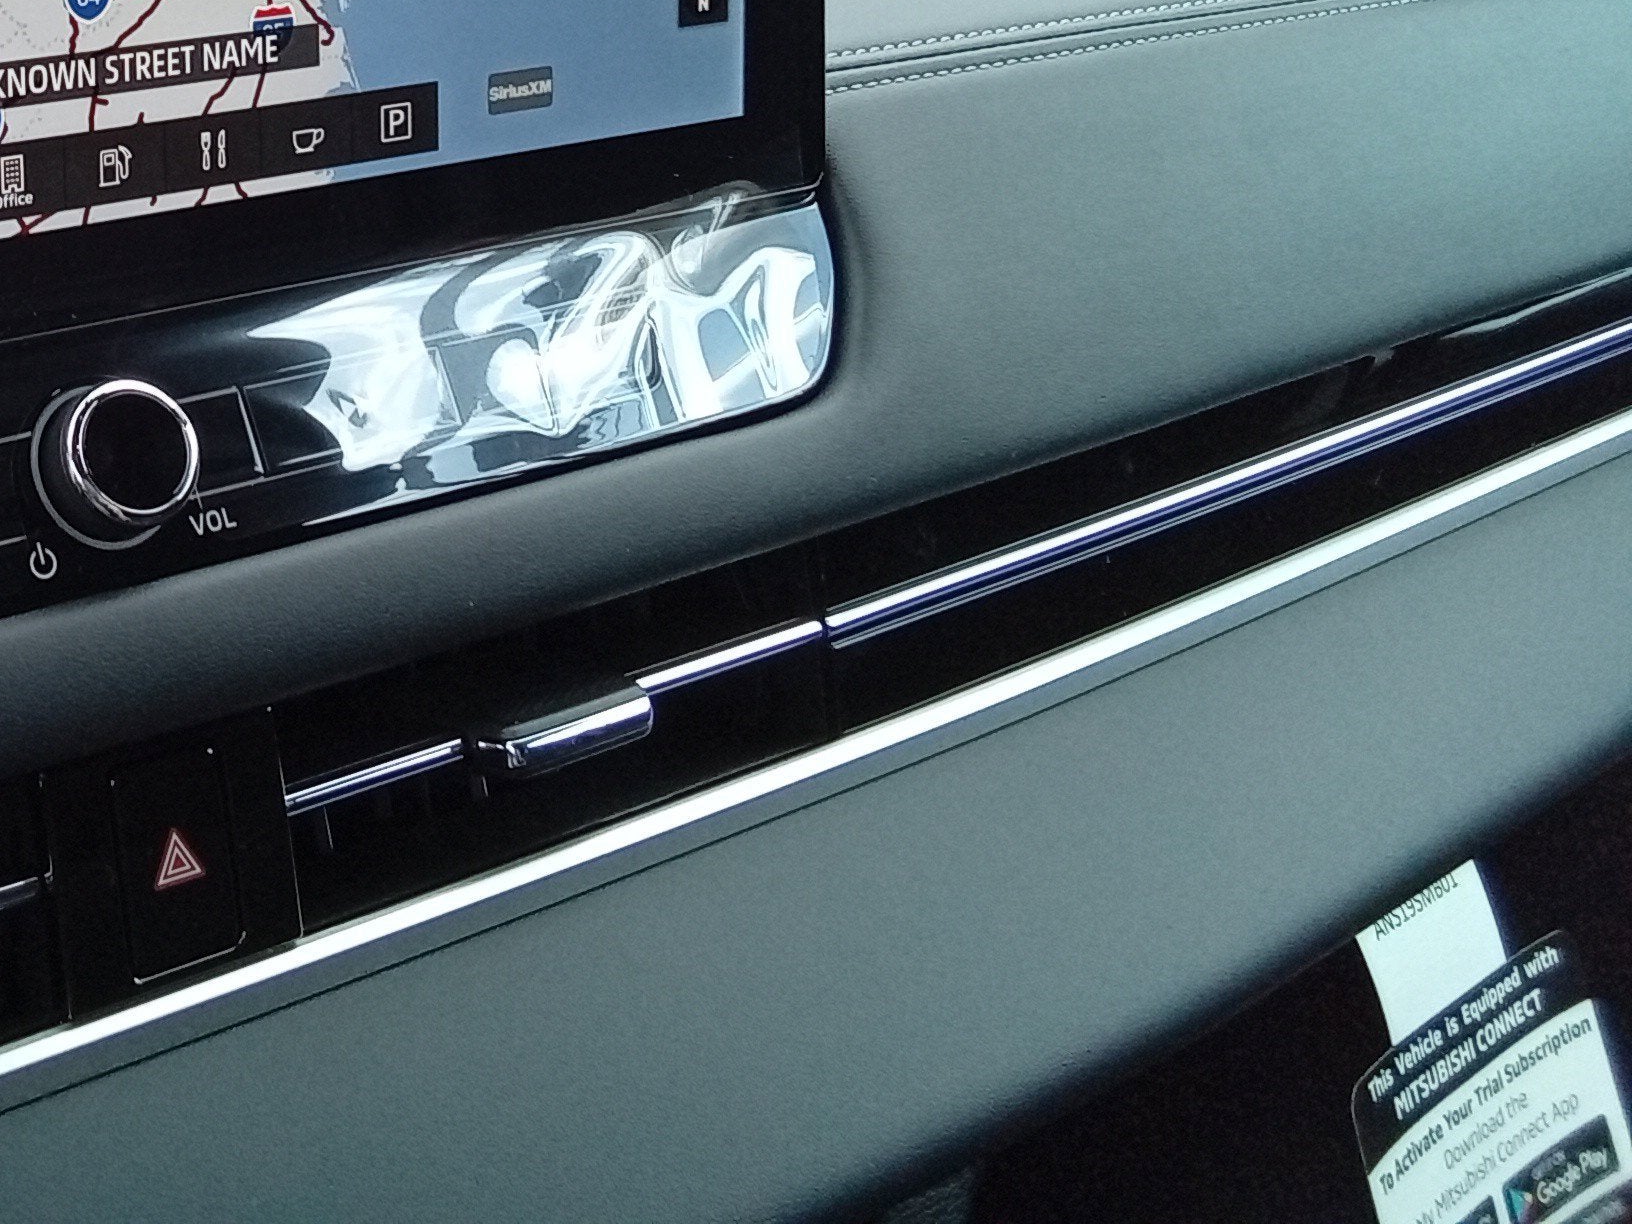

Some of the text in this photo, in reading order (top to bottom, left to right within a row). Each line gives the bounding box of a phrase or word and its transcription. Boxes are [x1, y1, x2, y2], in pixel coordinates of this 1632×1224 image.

[105, 45, 195, 84] STREET
[203, 34, 279, 72] NAME
[489, 79, 552, 102] SiriusXM
[389, 109, 405, 136] P
[188, 507, 238, 536] VOL
[1368, 946, 1560, 1103] This Vehicle is Equipped with
[1393, 988, 1542, 1120] MITSUBISHI CONNECT
[1380, 1018, 1593, 1195] To Activate Your Trial Subscription
[1444, 1110, 1506, 1170] Download
[1507, 1092, 1529, 1120] the
[1434, 1155, 1497, 1212] Mitsubishi
[1496, 1111, 1551, 1163] Connect
[1552, 1093, 1579, 1122] App
